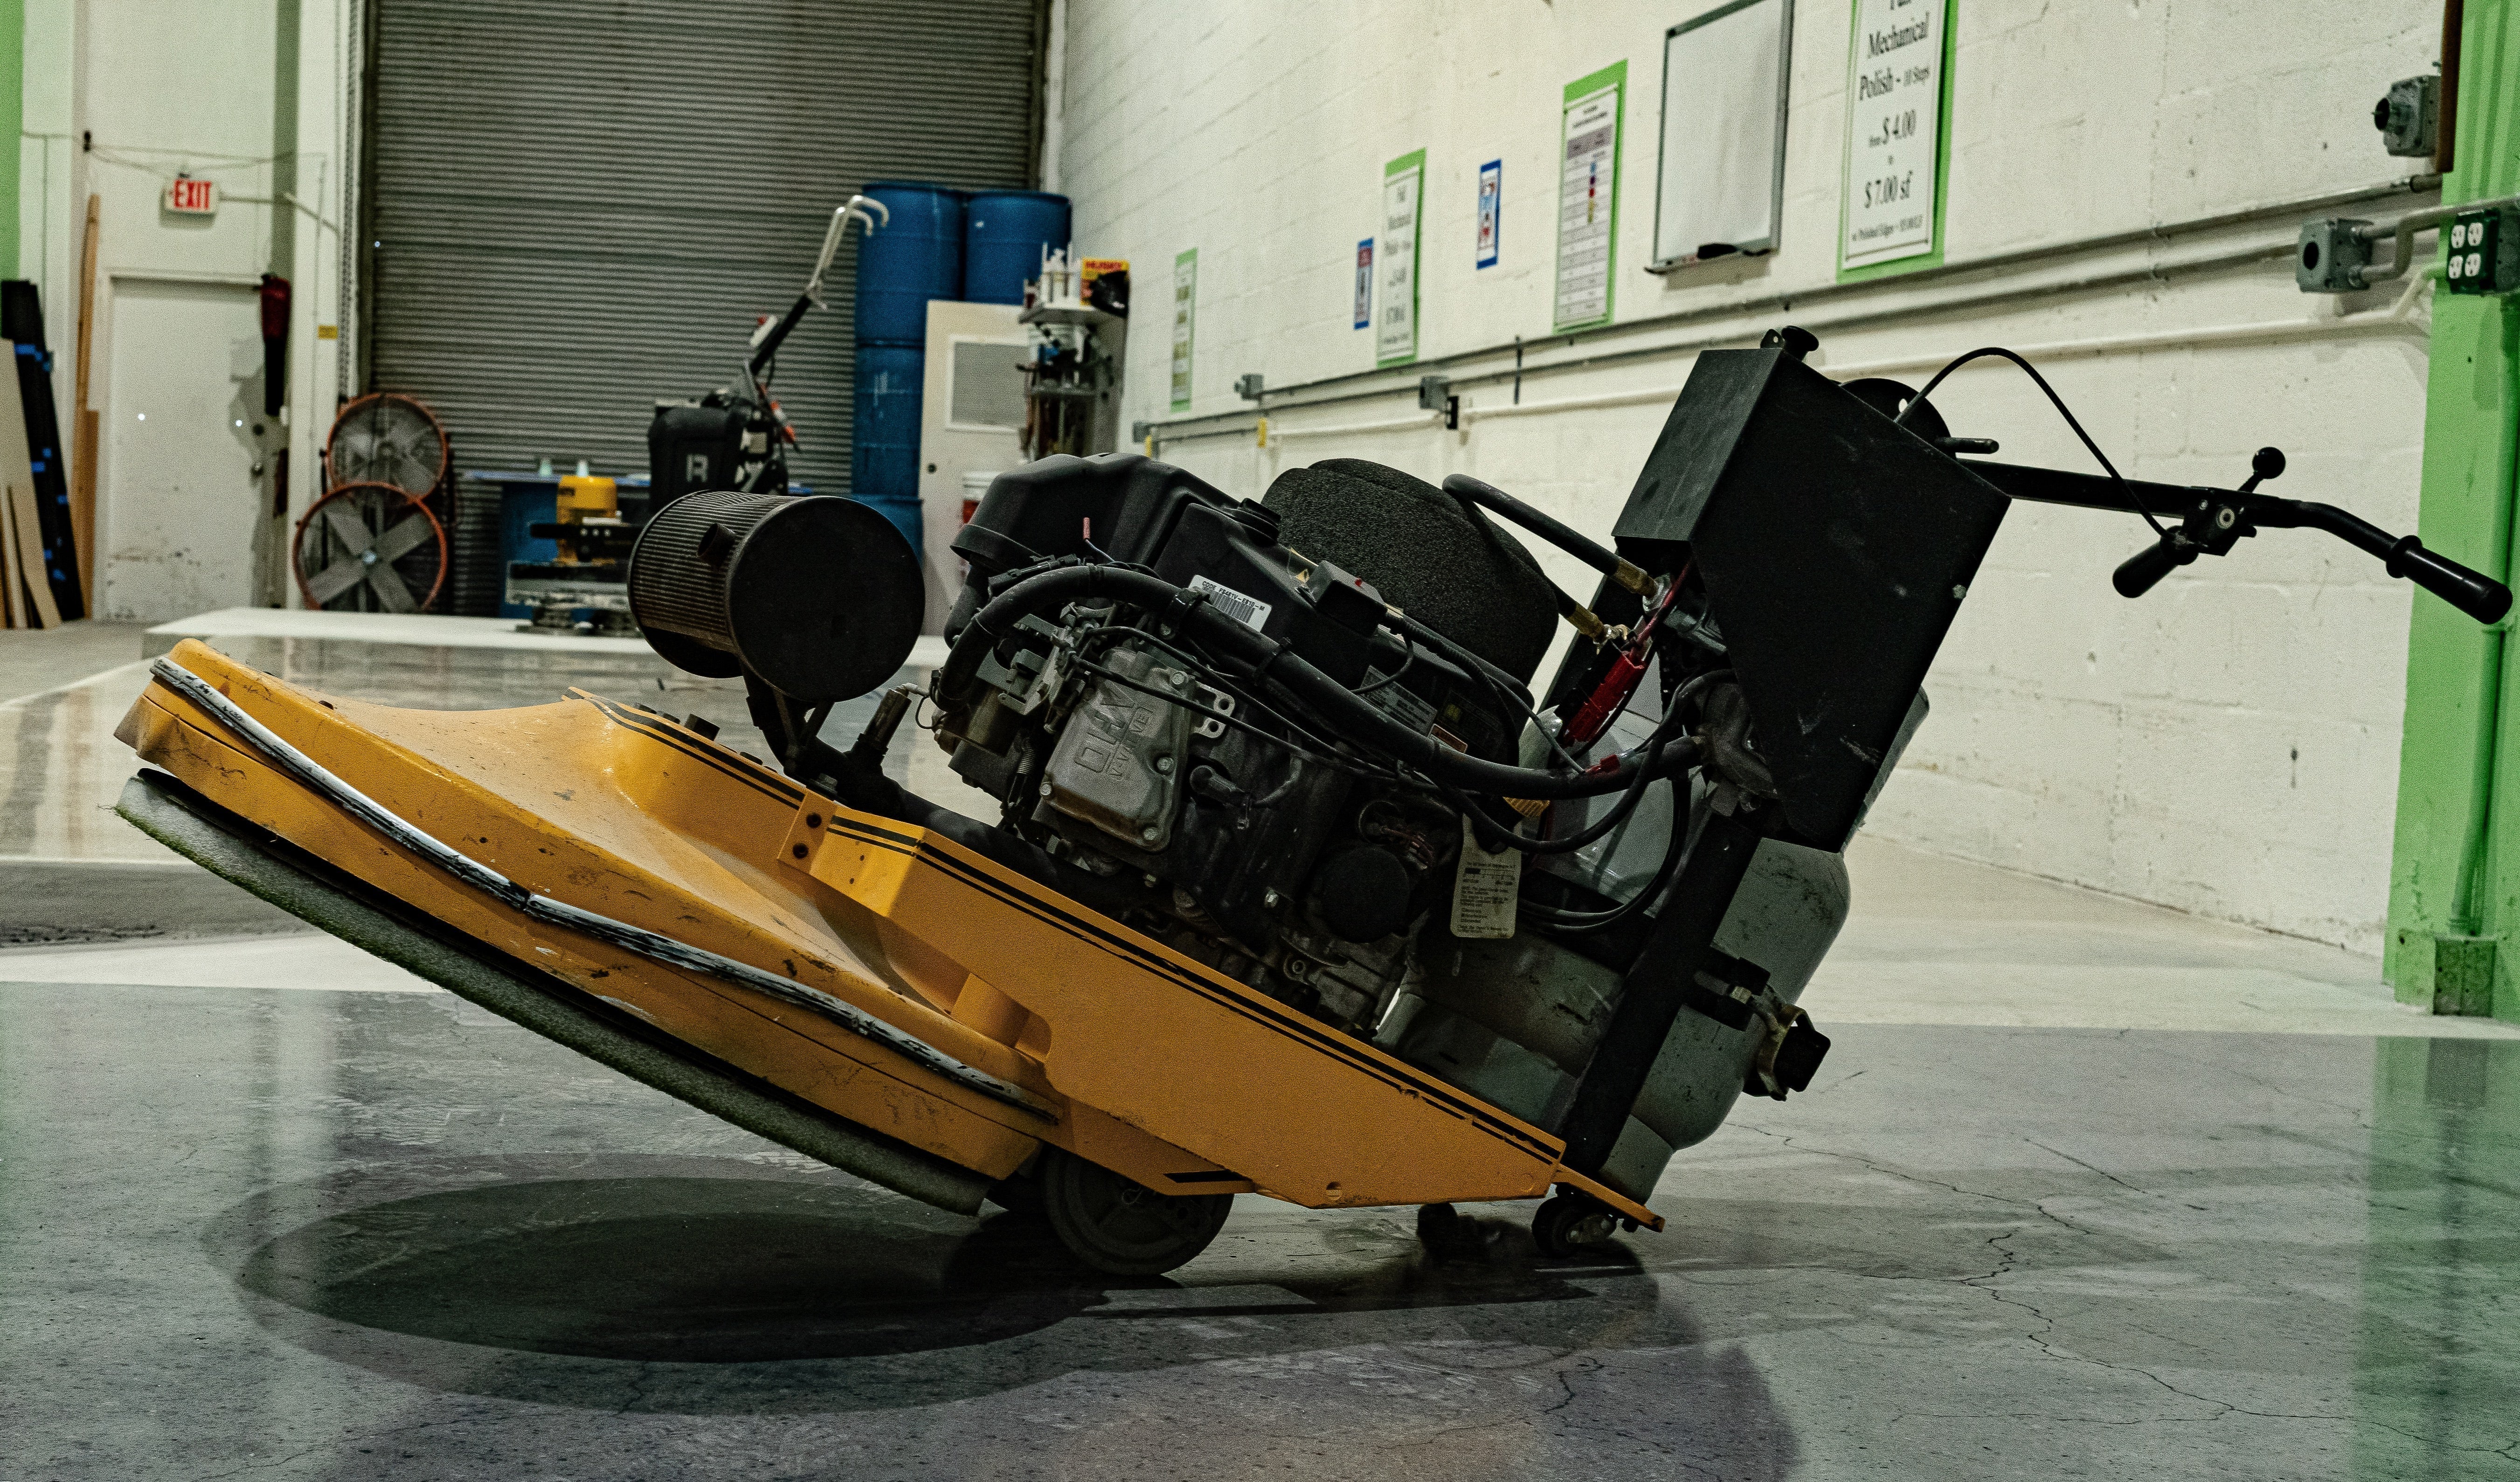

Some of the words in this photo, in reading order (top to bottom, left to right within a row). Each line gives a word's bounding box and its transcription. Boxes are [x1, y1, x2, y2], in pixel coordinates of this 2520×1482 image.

[1859, 68, 1893, 101] Polish
[174, 180, 212, 209] EXIT
[1202, 581, 1217, 591] CODE
